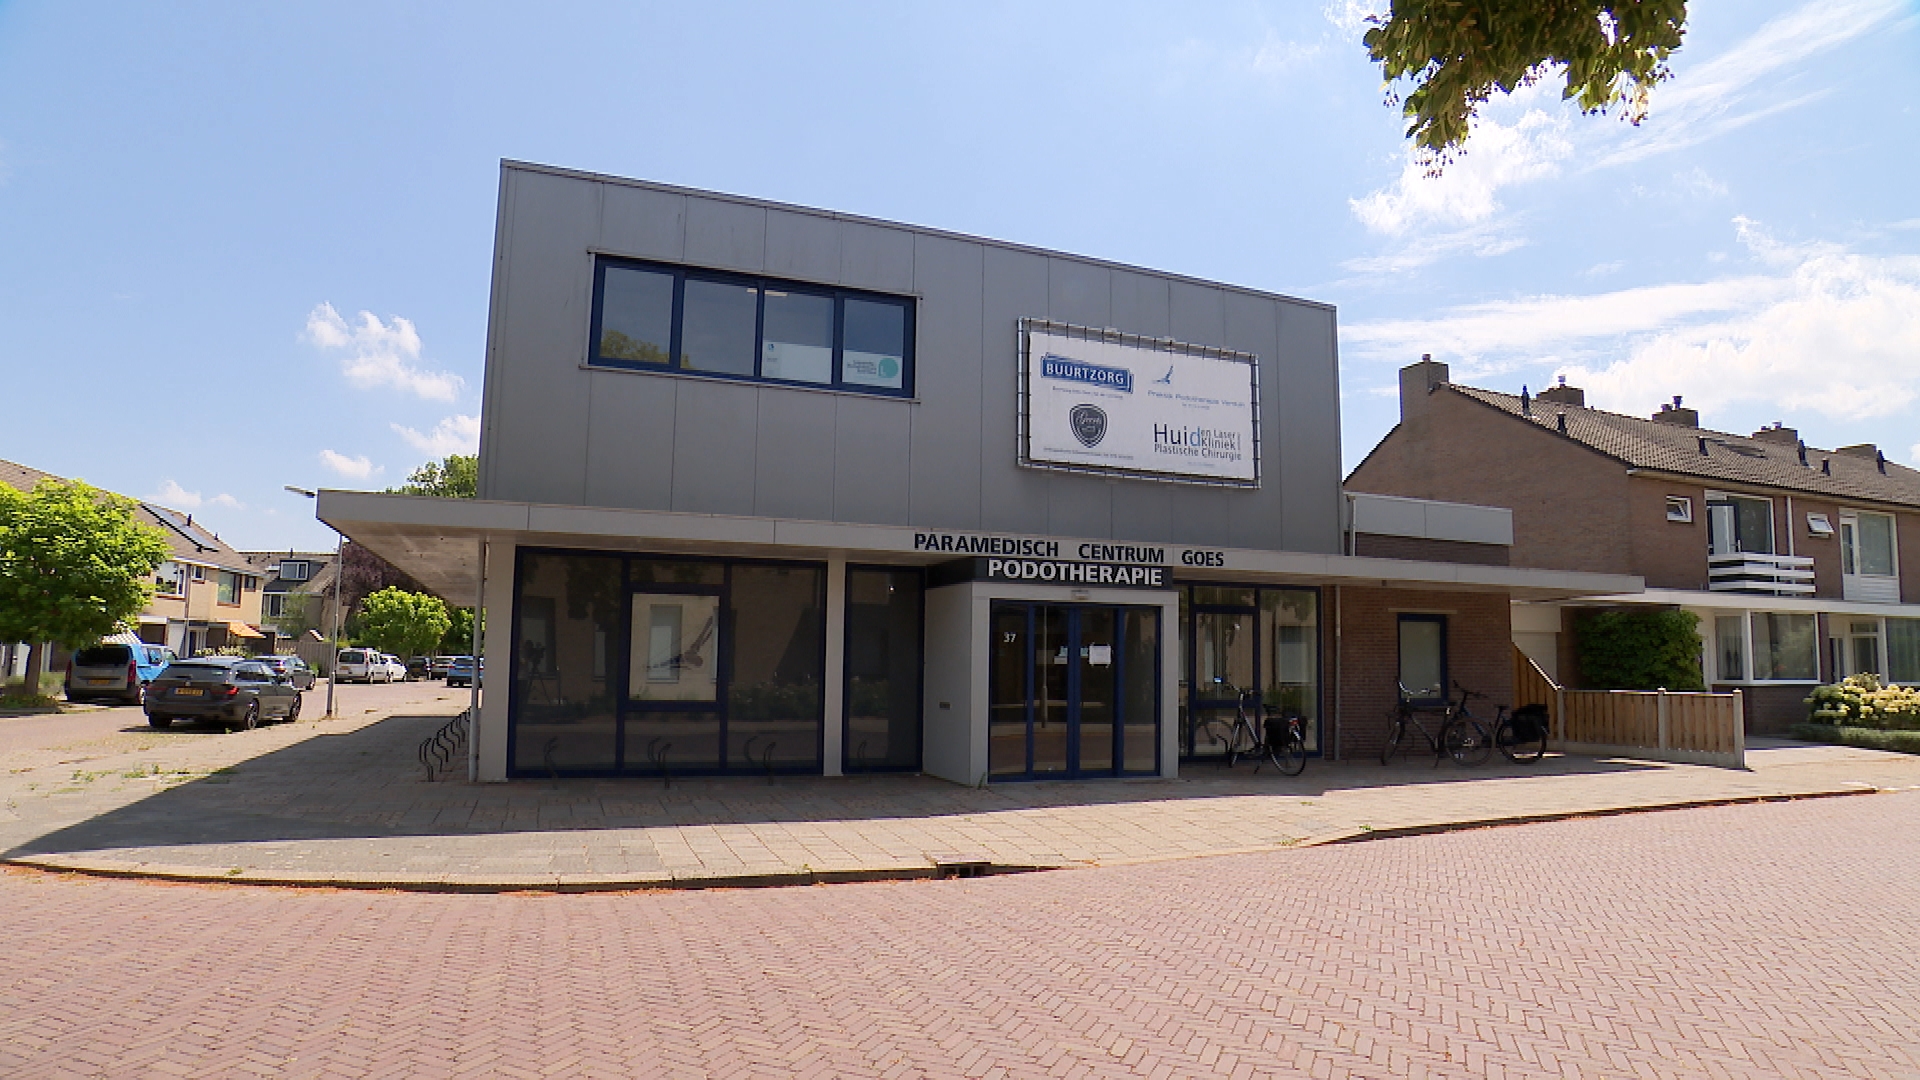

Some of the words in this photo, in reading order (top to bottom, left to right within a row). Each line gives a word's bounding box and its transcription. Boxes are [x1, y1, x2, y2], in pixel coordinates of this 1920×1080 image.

[1046, 363, 1124, 385] BUURTZORG
[1154, 423, 1200, 447] Huid
[1214, 428, 1236, 439] Laser
[1154, 443, 1199, 457] Plastische
[1201, 448, 1241, 462] Chirurgie
[1201, 437, 1236, 451] Kliniek
[914, 533, 1059, 557] PARAMEDISCH
[1078, 543, 1164, 563] CENTRUM
[1181, 550, 1224, 567] GOES
[988, 558, 1162, 585] PODOTHERAPIE
[1003, 632, 1016, 643] 37
